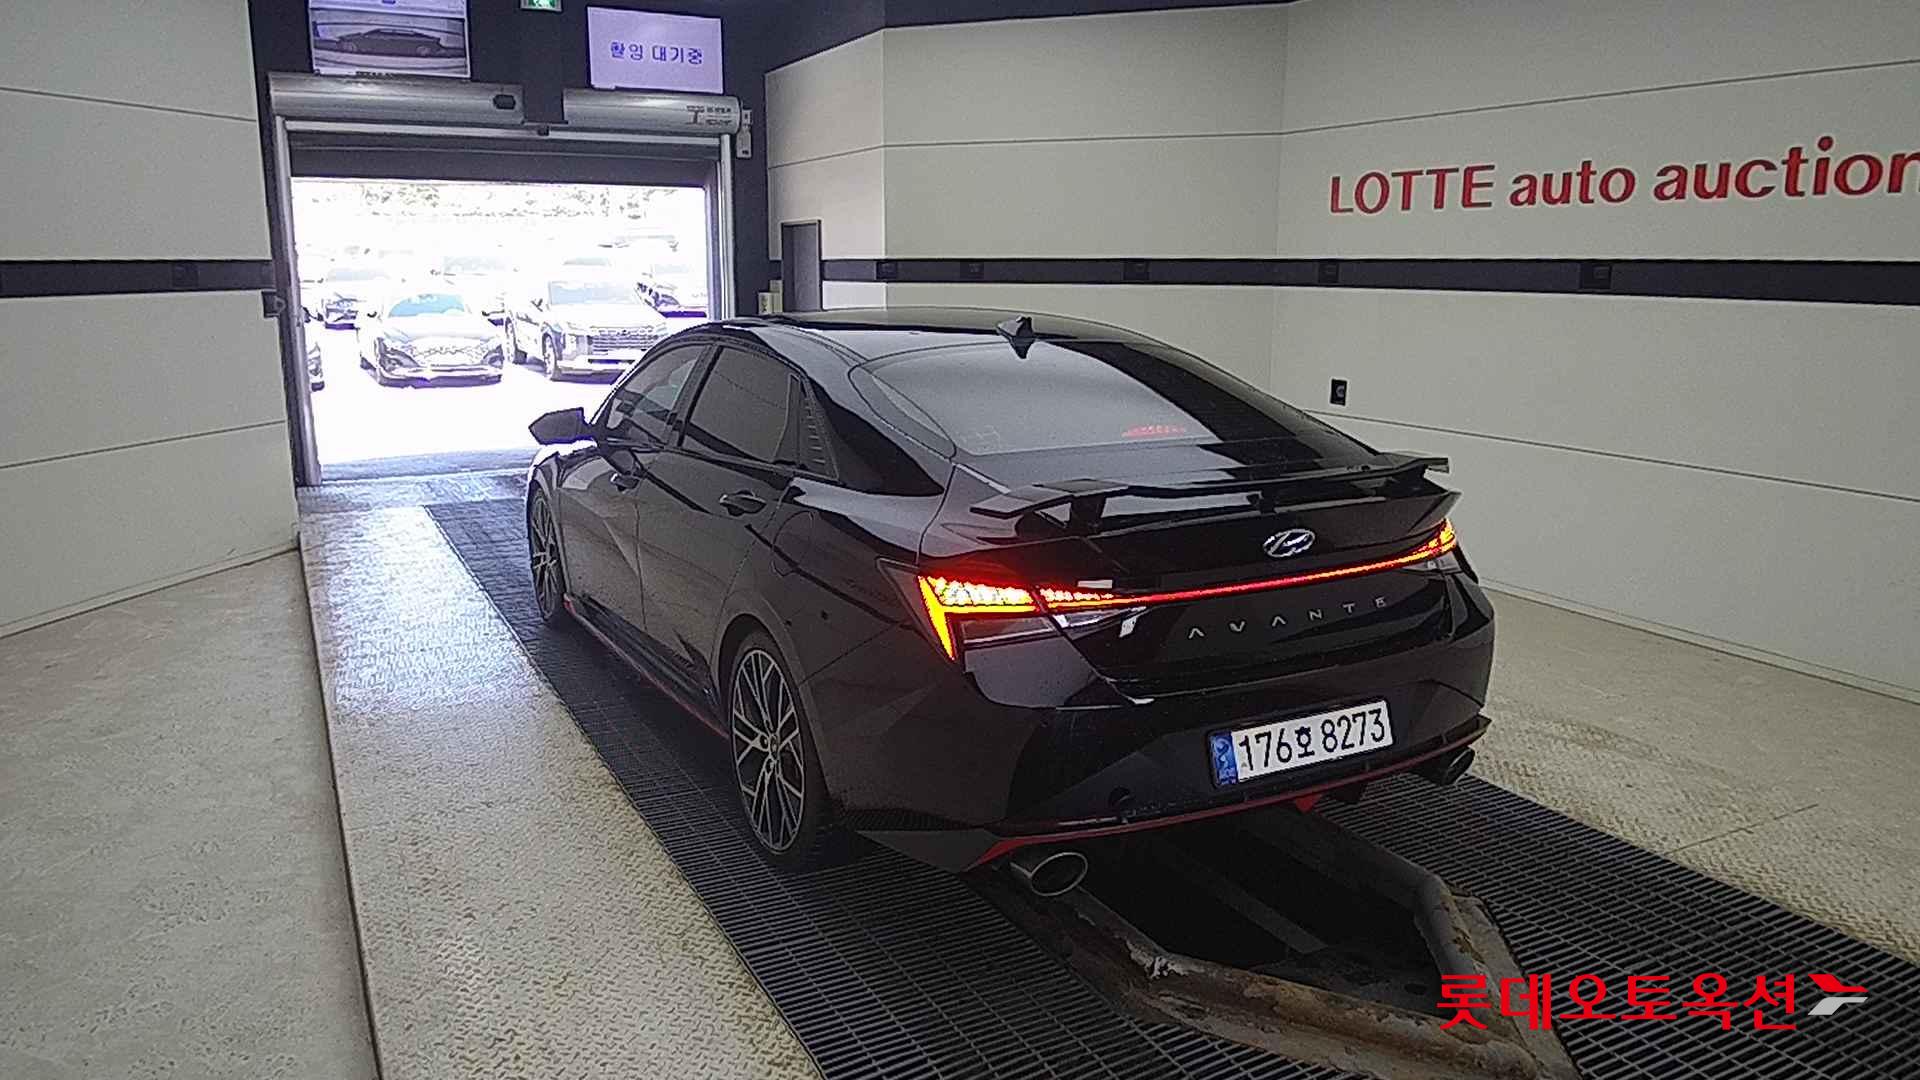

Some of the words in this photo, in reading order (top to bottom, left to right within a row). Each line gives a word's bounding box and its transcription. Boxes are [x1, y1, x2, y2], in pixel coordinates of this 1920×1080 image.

[652, 45, 702, 65] 대기중
[1330, 164, 1496, 213] LOTTE
[1509, 160, 1636, 206] auto
[1653, 136, 1920, 200] auction
[1188, 597, 1387, 640] AVANTE
